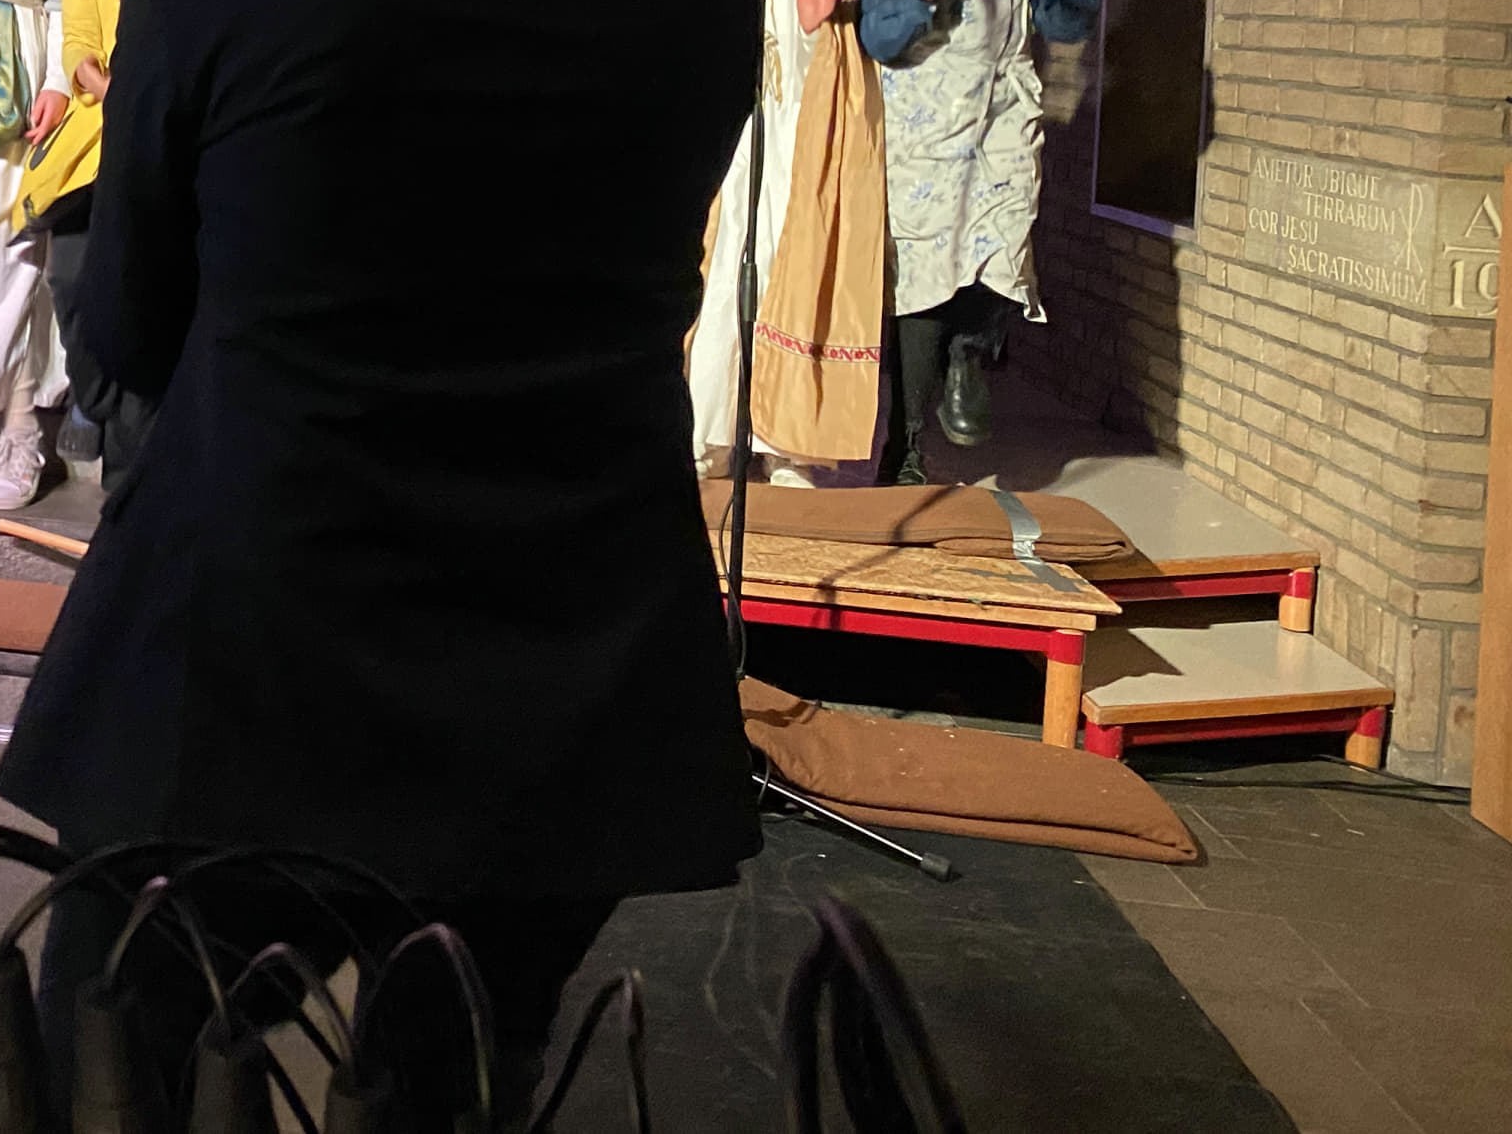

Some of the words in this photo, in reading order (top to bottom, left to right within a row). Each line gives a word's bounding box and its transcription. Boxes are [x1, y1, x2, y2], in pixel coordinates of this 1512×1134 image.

[1253, 156, 1313, 189] AMETUR
[1319, 168, 1382, 201] UBIQUE
[1248, 207, 1279, 235] COR
[1281, 215, 1319, 246] JESU
[1303, 191, 1396, 235] TERRARUM
[1288, 244, 1427, 306] SACRATISSIMUM
